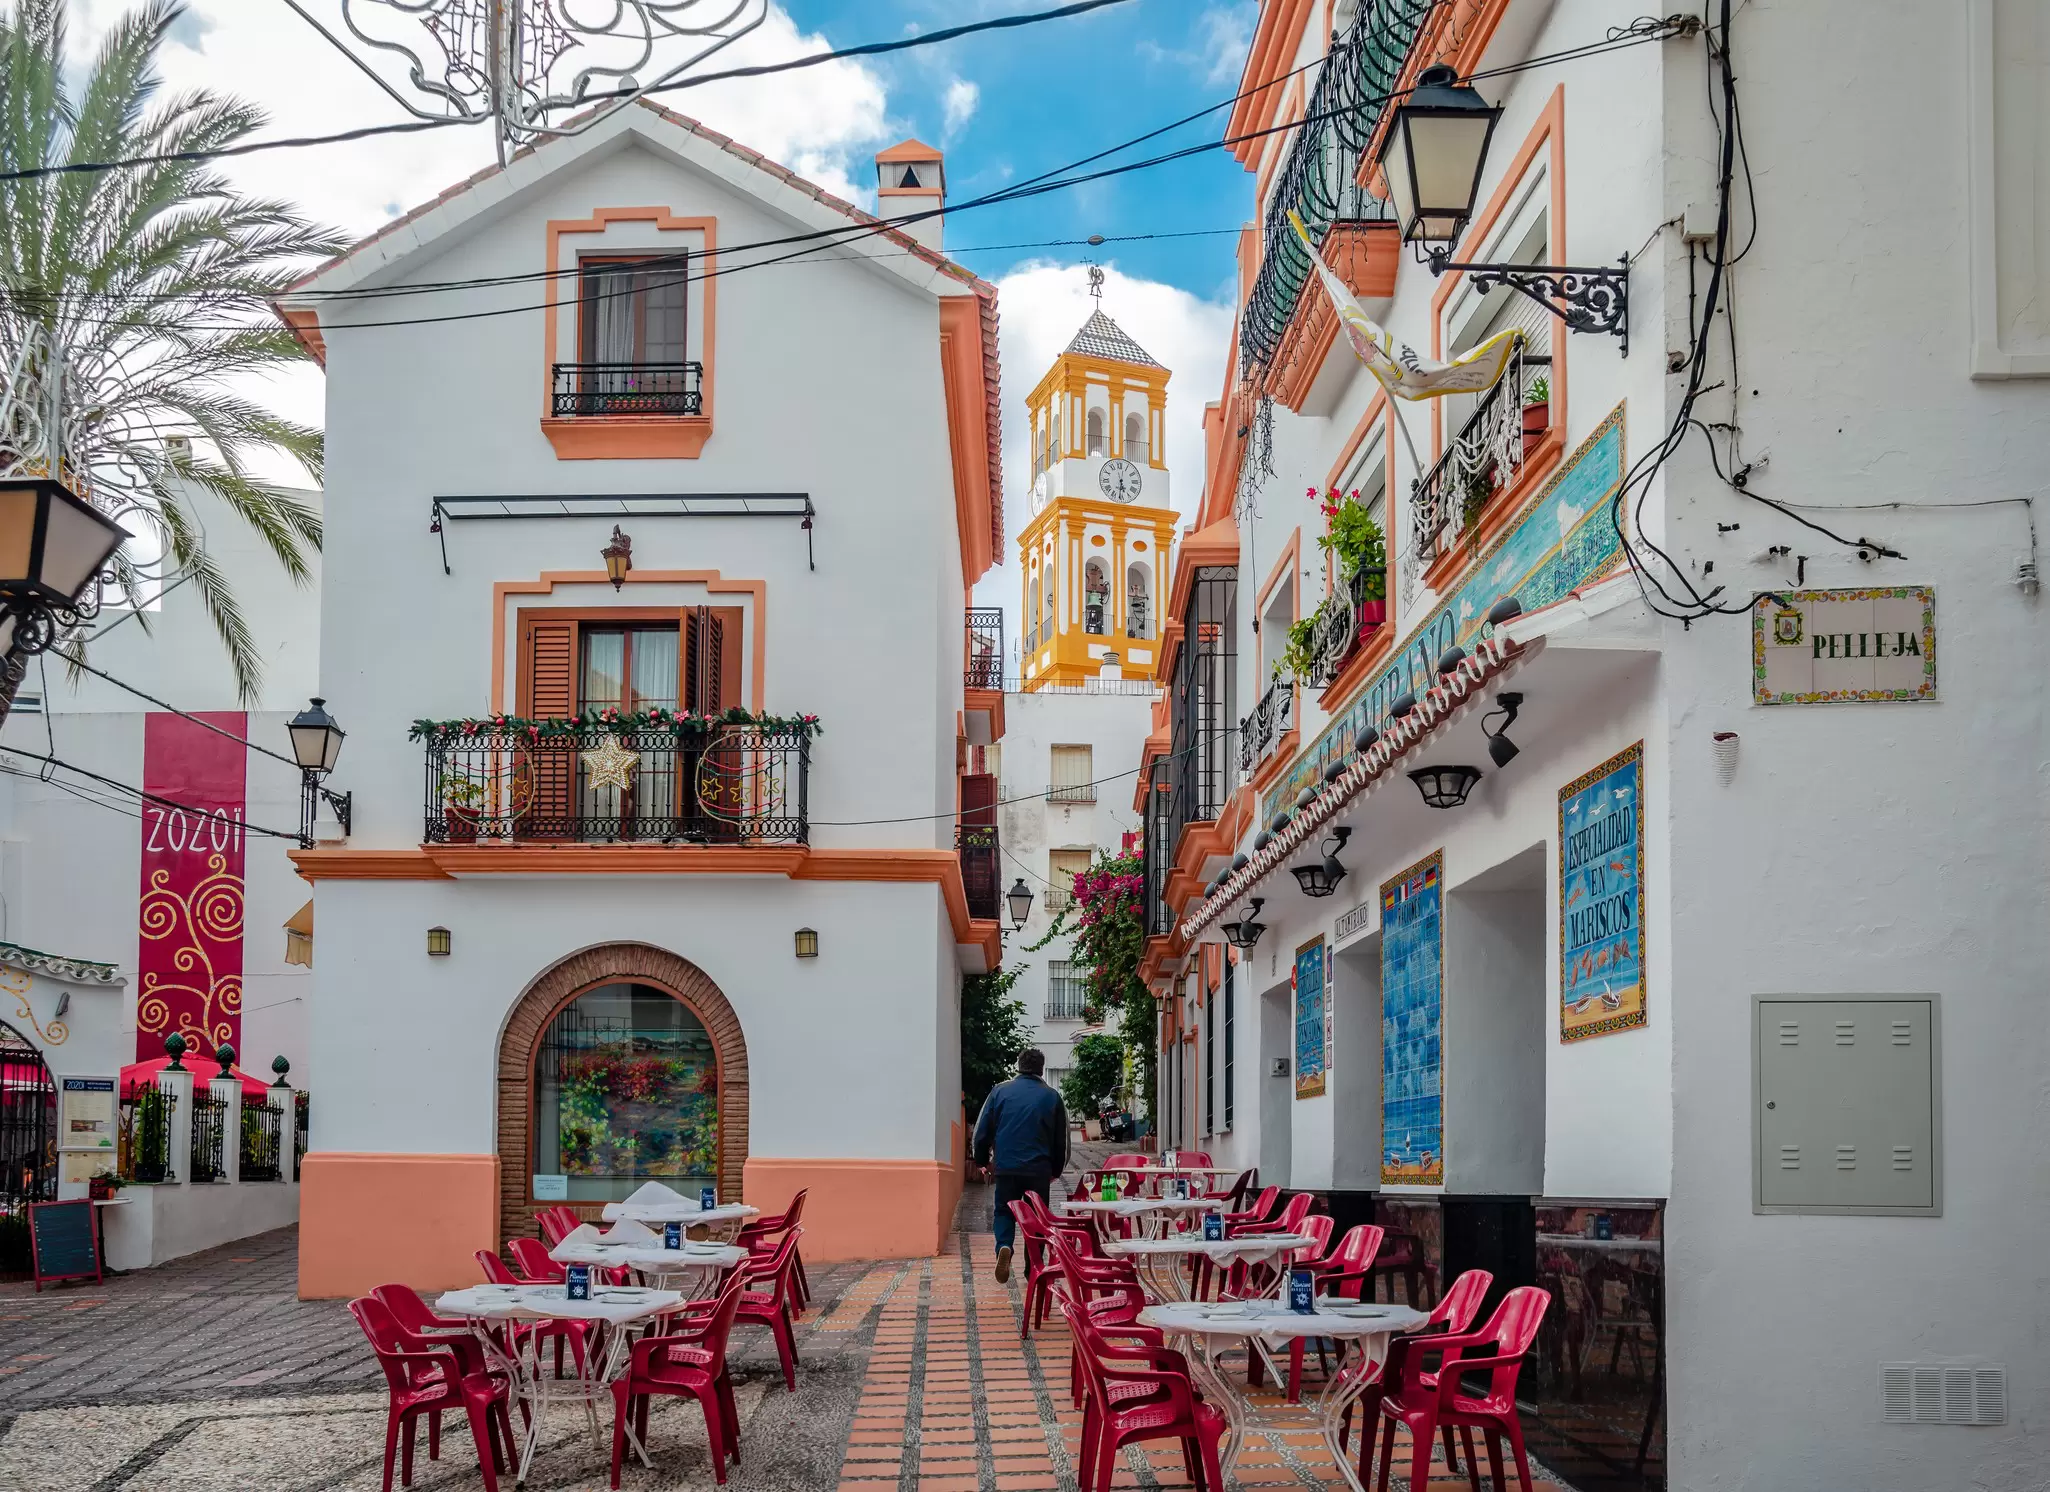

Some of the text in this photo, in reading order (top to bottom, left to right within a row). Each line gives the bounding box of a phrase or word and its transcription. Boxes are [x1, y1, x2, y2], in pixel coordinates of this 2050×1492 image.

[1811, 631, 1922, 660] PELLEJA
[1568, 806, 1631, 872] ESPECIALIDAD
[1591, 864, 1606, 897] EN
[1335, 905, 1368, 938] ALTAMIRANO
[1570, 891, 1631, 950] MARISCOS
